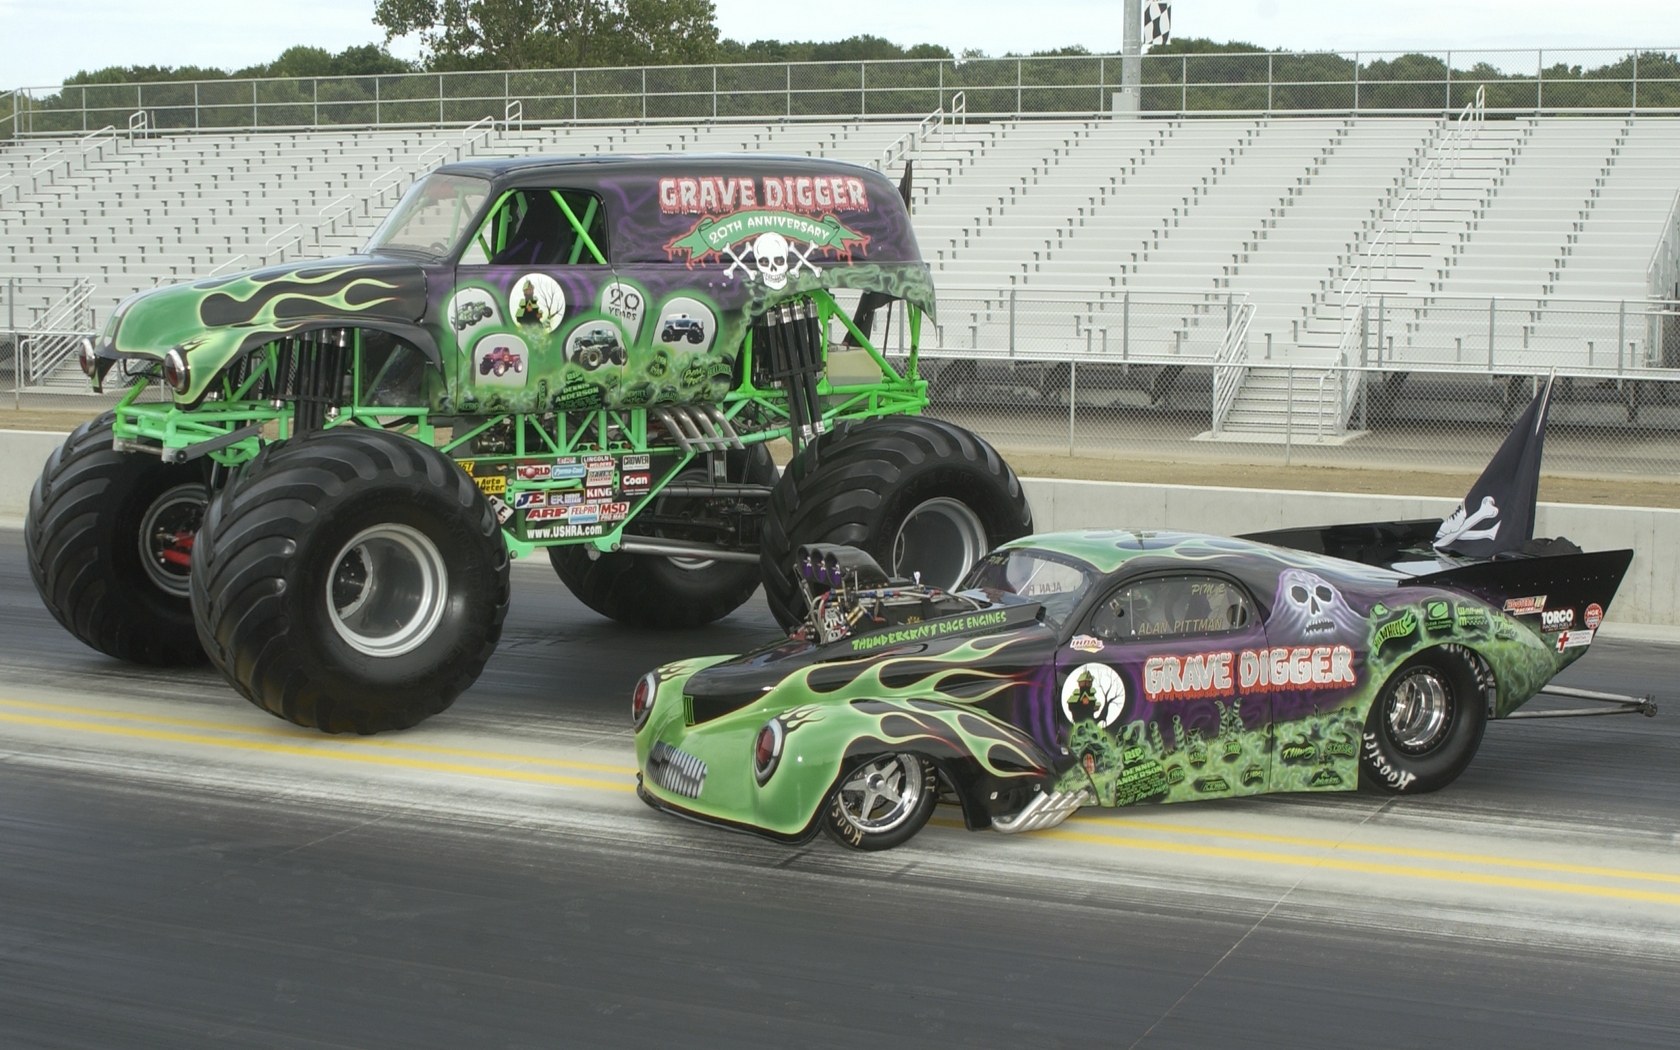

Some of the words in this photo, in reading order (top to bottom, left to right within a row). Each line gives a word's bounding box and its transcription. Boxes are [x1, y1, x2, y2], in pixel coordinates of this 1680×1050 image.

[659, 177, 757, 213] GRAVE
[763, 176, 870, 213] DIGGER
[708, 221, 743, 245] 20TH
[747, 216, 830, 240] ANNIVERSARY
[610, 288, 640, 312] 20
[608, 306, 637, 321] YEARS
[555, 386, 599, 403] ANDERSON
[562, 382, 590, 394] DENNIS
[582, 454, 610, 463] LINCOLN
[623, 455, 649, 465] CROWER
[517, 466, 551, 479] WORLD
[622, 475, 648, 485] Coan
[516, 491, 546, 508] JE
[586, 487, 613, 498] KING
[527, 508, 568, 519] ARP
[601, 502, 627, 514] MSD
[527, 524, 603, 539] www.USHRA.com
[1541, 608, 1574, 625] TORCO
[851, 623, 939, 651] THUNDERCRAFT
[938, 618, 964, 634] RACE
[966, 611, 1007, 629] ENGINES
[1138, 622, 1168, 636] ALAN
[1173, 618, 1224, 633] PITTMAN
[1380, 619, 1407, 639] WHEELS
[1144, 652, 1235, 700] GRAVE
[1238, 646, 1356, 694] DIGGER
[1124, 747, 1143, 762] RIP
[1363, 732, 1418, 790] Hoosier
[1116, 765, 1163, 786] ANDERSON
[1122, 760, 1156, 777] DENNIS
